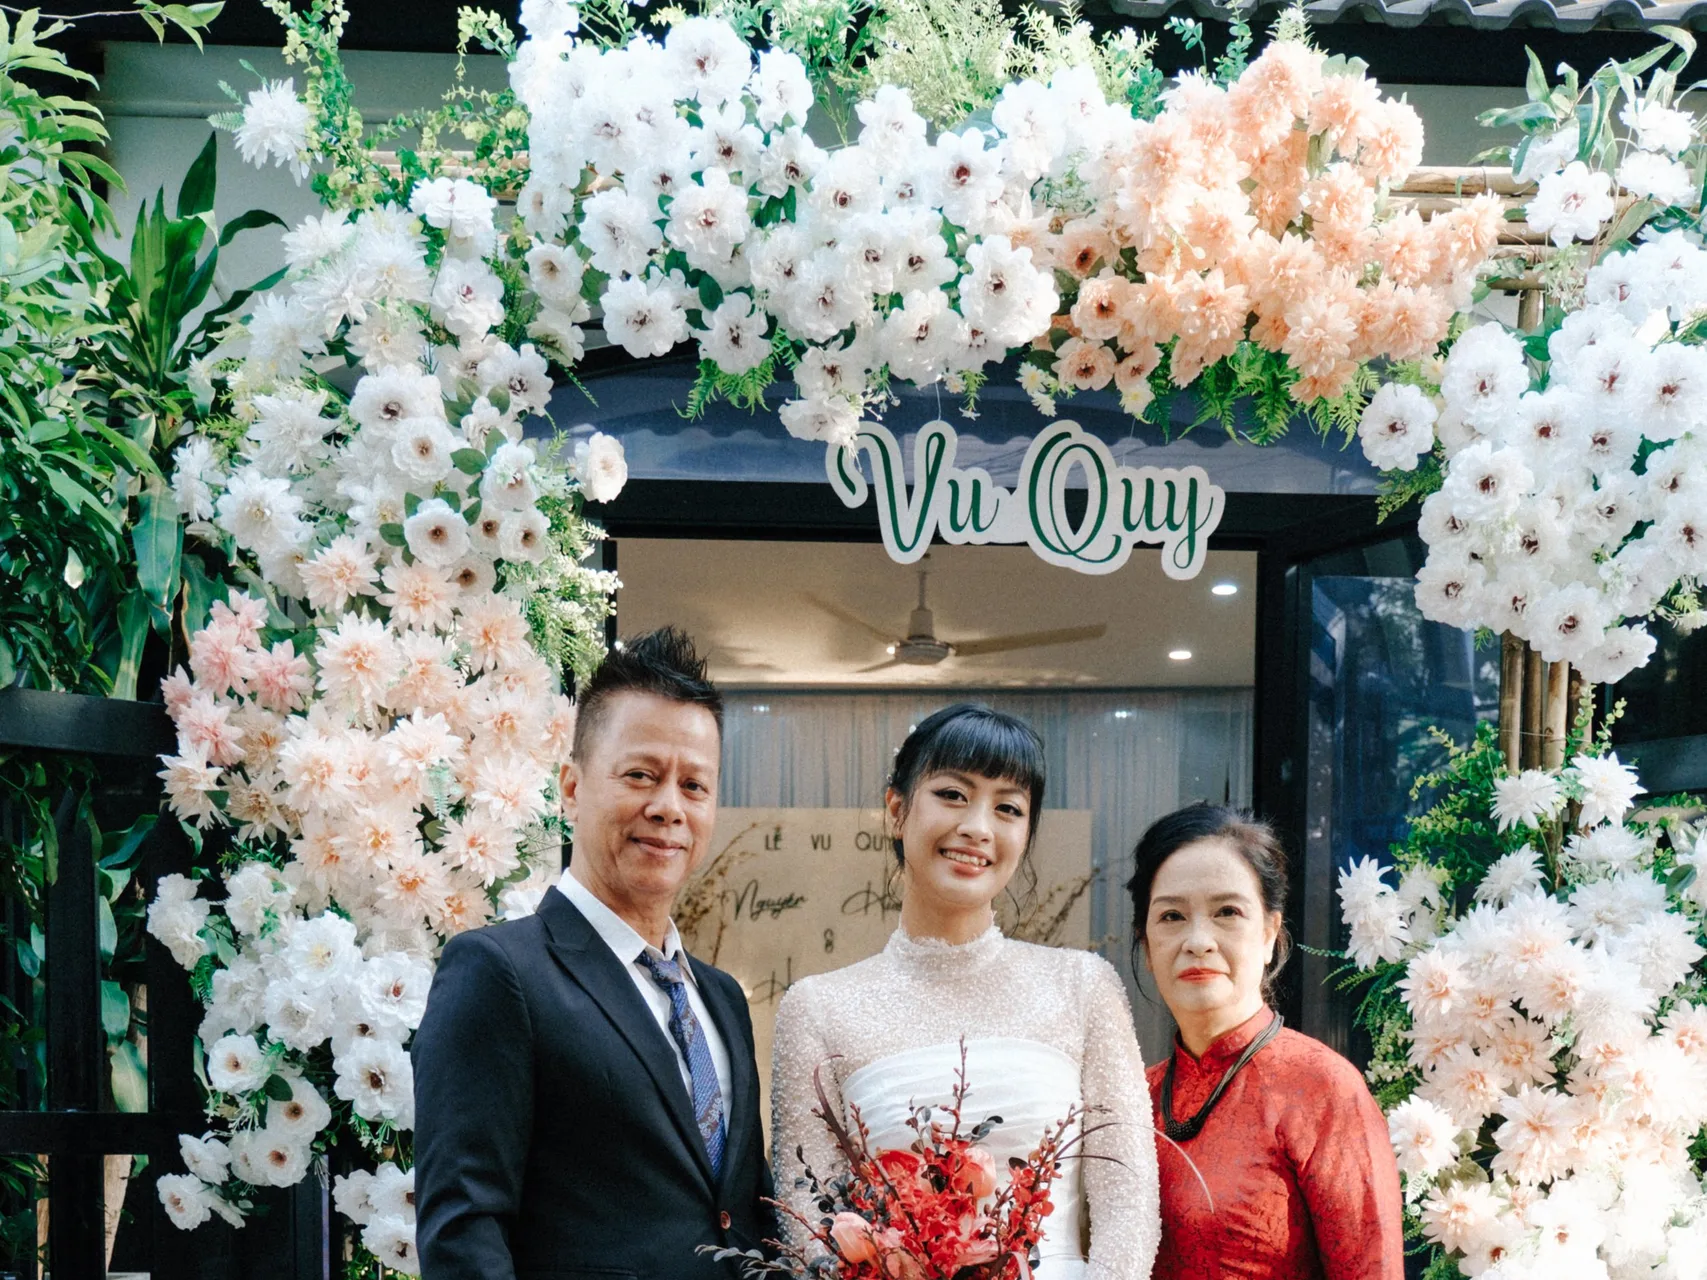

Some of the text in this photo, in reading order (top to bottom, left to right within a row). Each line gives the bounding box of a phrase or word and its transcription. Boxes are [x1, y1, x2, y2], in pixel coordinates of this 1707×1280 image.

[836, 431, 1214, 570] Vu Quy
[810, 833, 831, 851] VU
